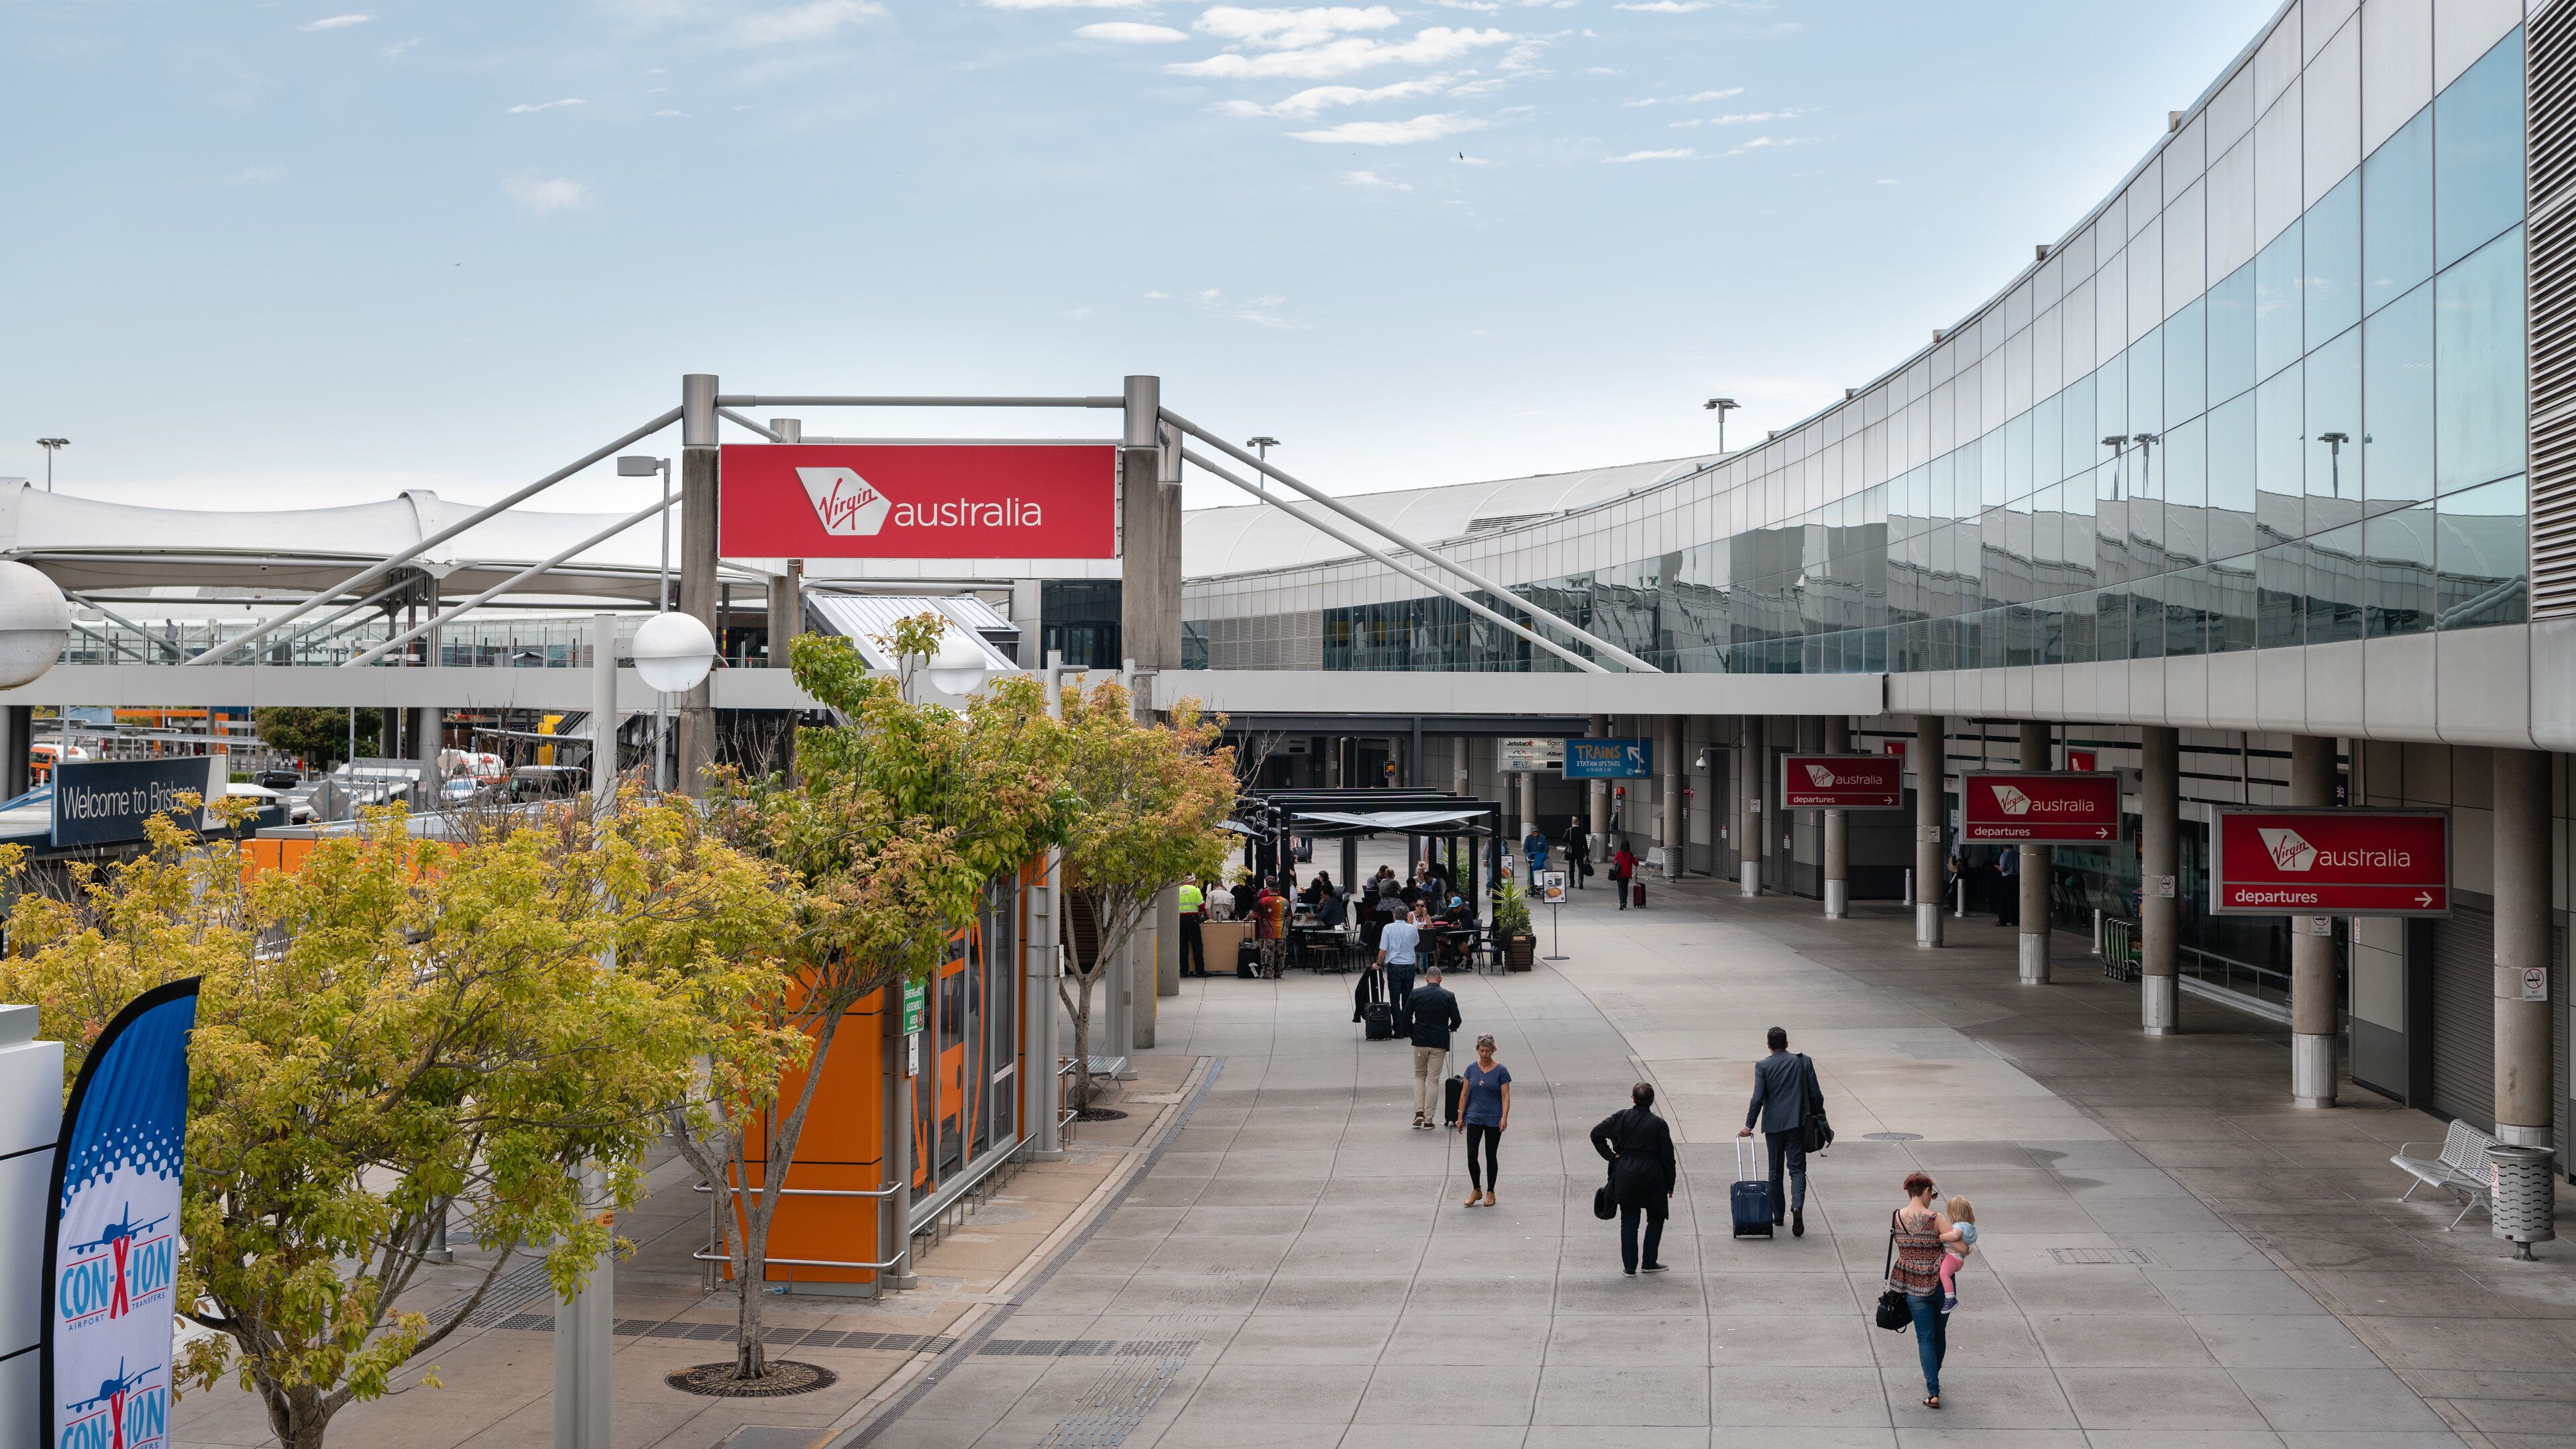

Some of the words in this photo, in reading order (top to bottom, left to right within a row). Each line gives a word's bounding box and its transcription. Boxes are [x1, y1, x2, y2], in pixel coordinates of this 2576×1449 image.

[819, 478, 878, 531] Virgin
[894, 498, 1041, 527] australia
[1812, 768, 1831, 786] Virgin
[1835, 775, 1882, 785] australia
[62, 786, 129, 820] Welcome
[133, 786, 147, 814] to
[1793, 796, 1835, 804] departures
[2000, 790, 2026, 812] Virgin
[2032, 799, 2094, 812] australia
[1974, 826, 2031, 837] departures
[2272, 835, 2310, 868] Virgin
[2319, 849, 2411, 867] australia
[2235, 890, 2318, 905] departures
[906, 1000, 922, 1013] ASSEMBLY
[909, 1014, 918, 1026] AREA
[68, 1314, 105, 1332] AIRPORT
[131, 1292, 166, 1310] TRANSFERS
